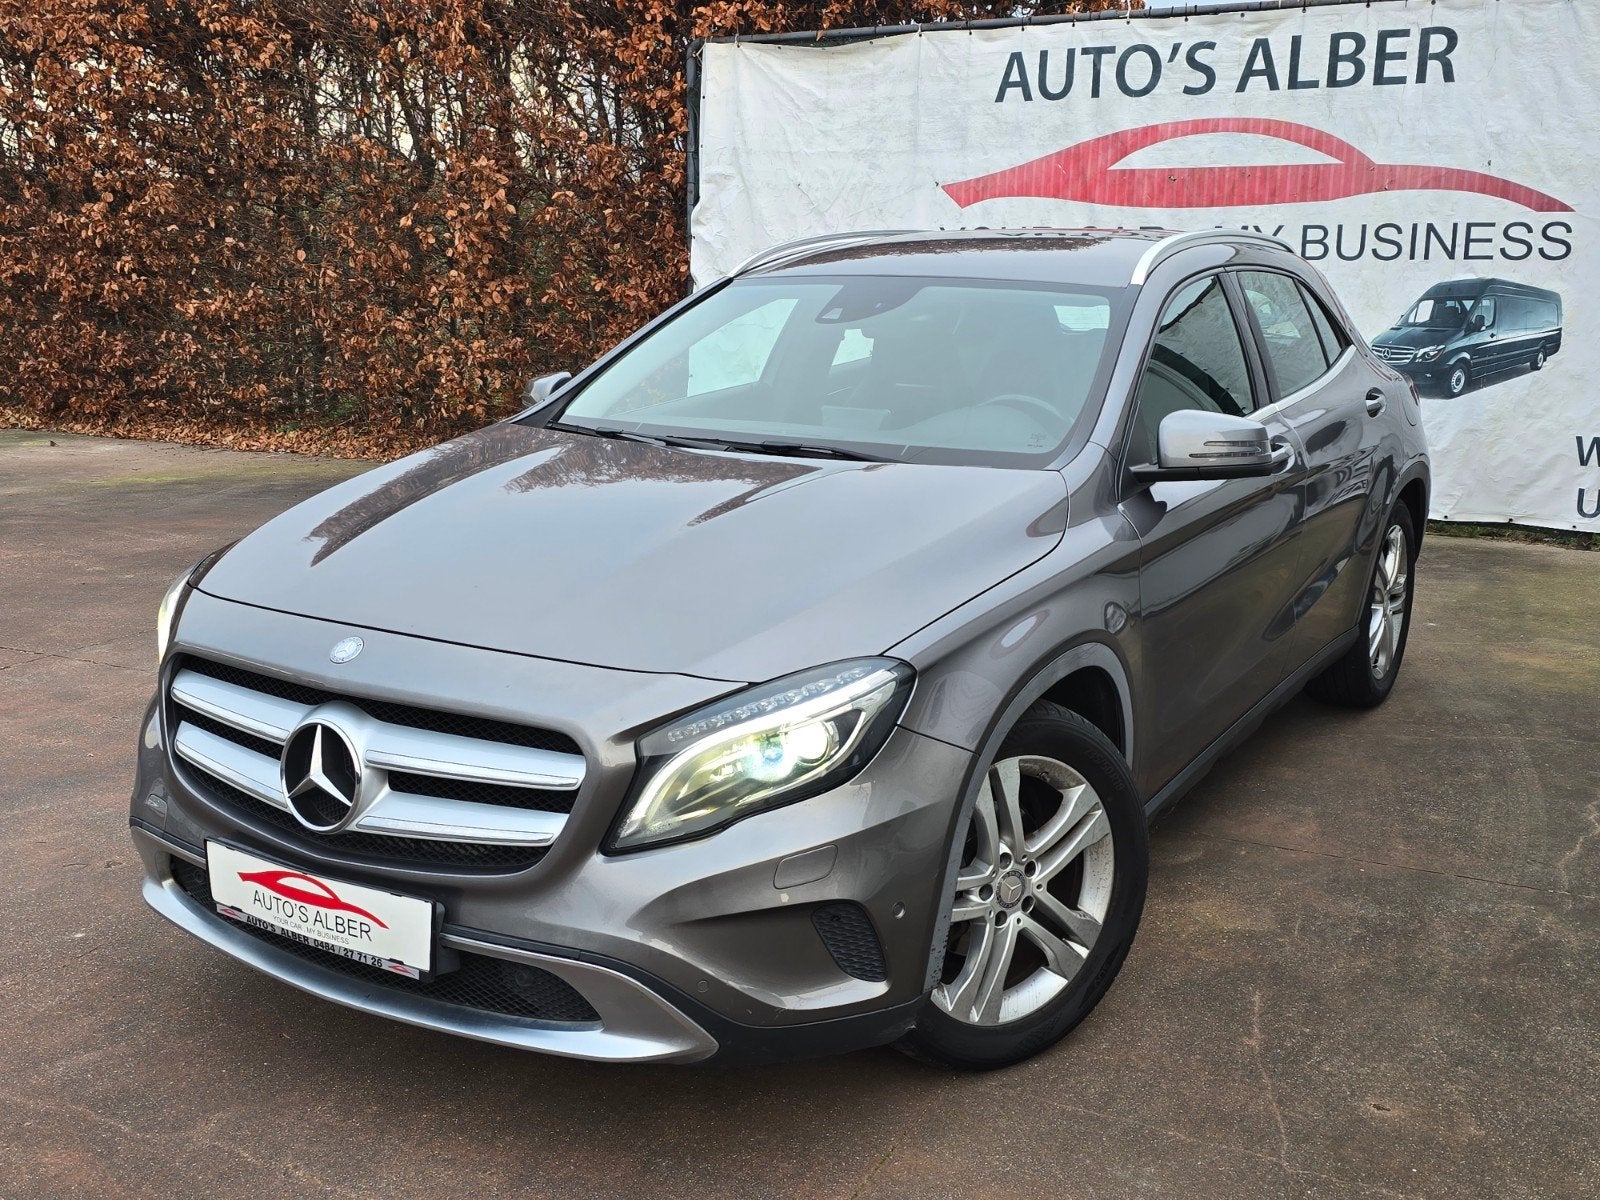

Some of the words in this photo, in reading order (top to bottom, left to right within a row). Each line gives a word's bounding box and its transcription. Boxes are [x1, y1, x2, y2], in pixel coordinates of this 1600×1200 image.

[994, 40, 1217, 103] AUTO'S
[1235, 26, 1459, 93] ALBER
[1300, 221, 1573, 262] BUSINESS
[246, 915, 276, 933] AUTO'S
[280, 927, 310, 944] ALBER
[313, 939, 336, 953] 0484
[343, 948, 354, 959] 27
[357, 952, 368, 963] 71
[371, 956, 383, 968] 26
[253, 890, 309, 923] AUTO'S
[313, 910, 373, 942] ALBER
[273, 915, 289, 927] YOUR
[289, 921, 302, 930] CAR
[306, 926, 317, 935] MY
[316, 928, 350, 945] BUSINESS
